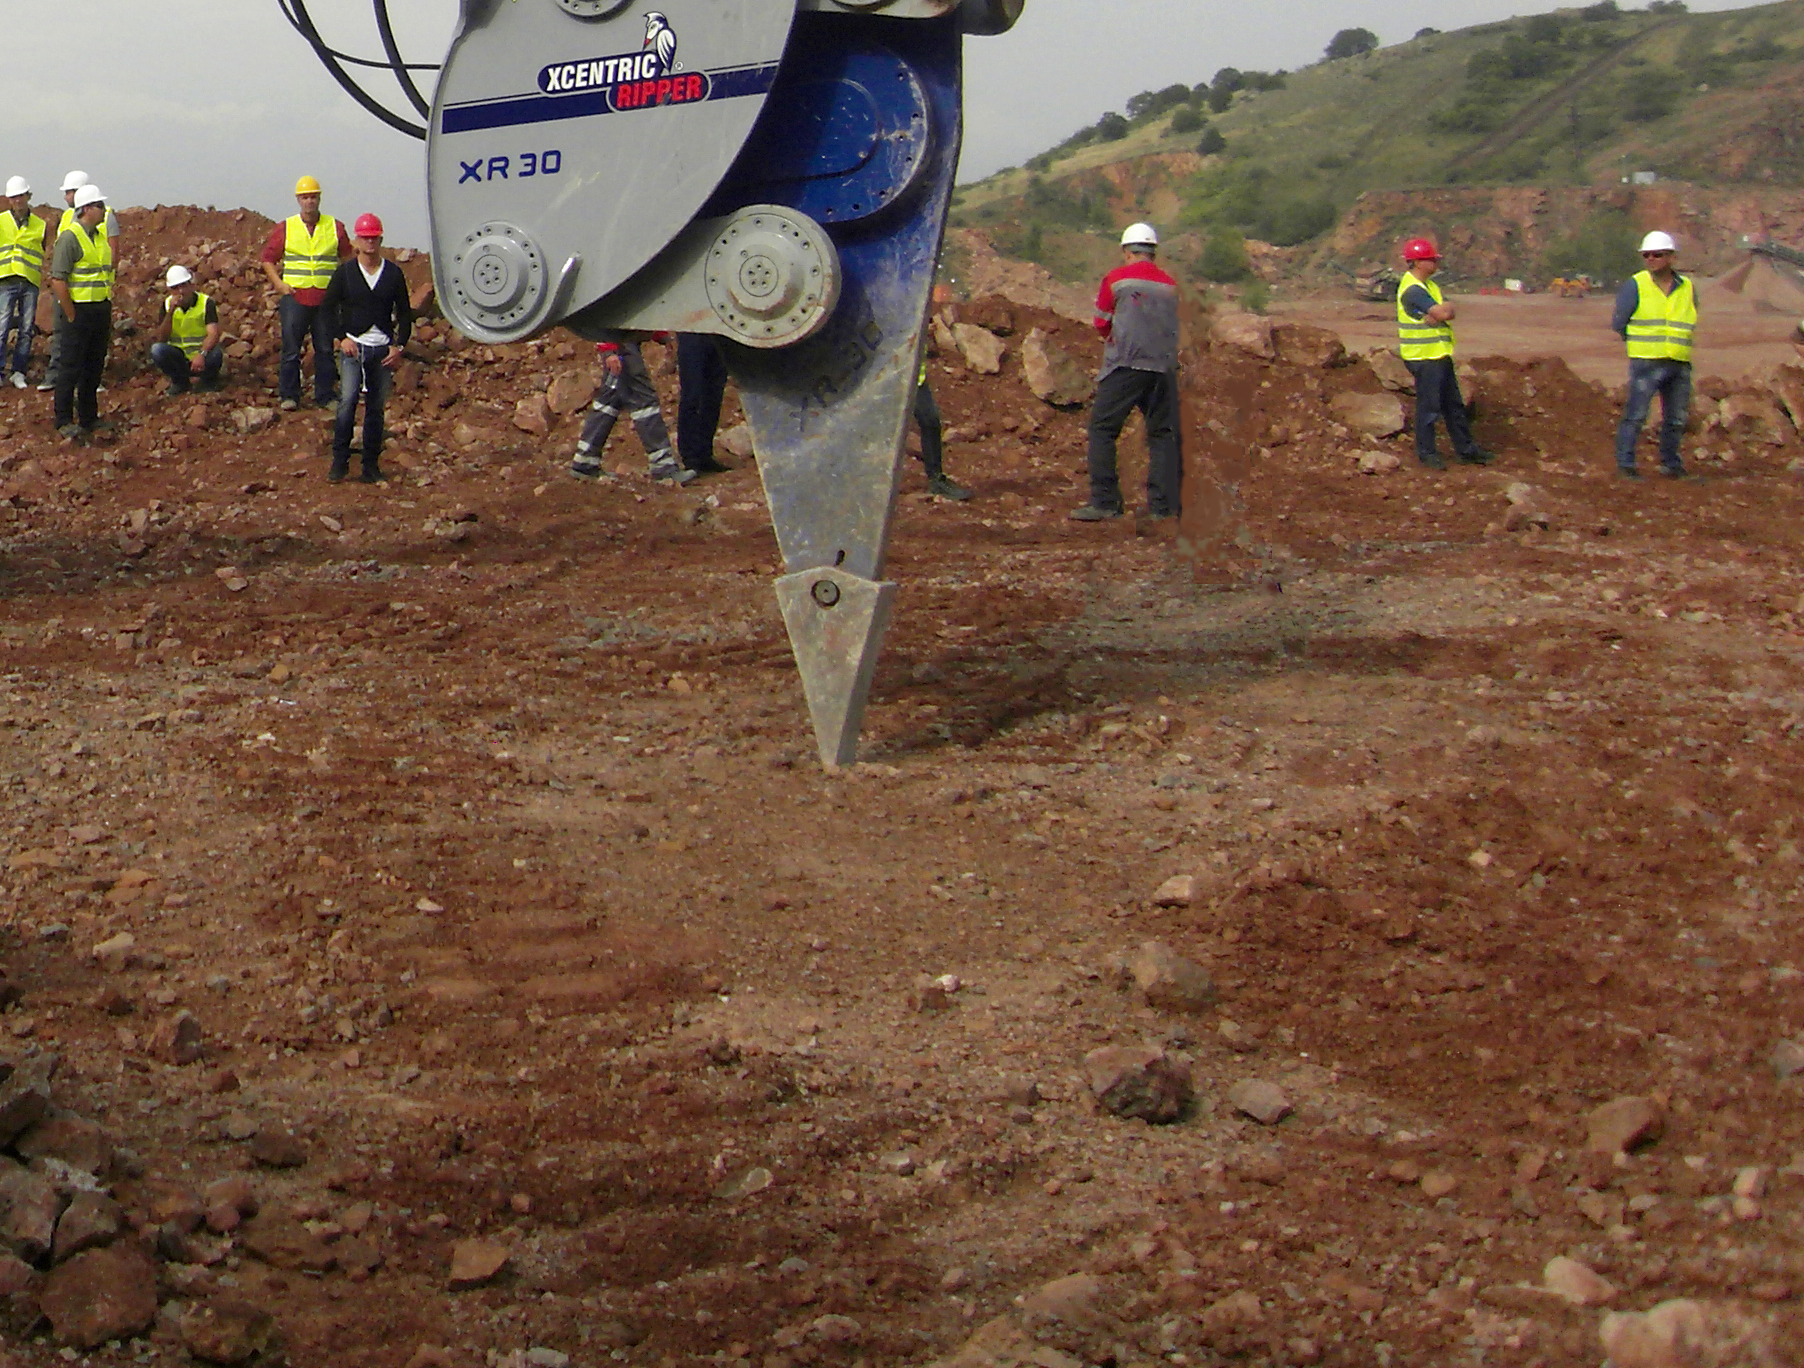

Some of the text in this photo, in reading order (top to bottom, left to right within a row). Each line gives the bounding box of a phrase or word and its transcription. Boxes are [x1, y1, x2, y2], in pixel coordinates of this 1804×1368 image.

[546, 53, 657, 92] XCENTRIC
[615, 75, 702, 109] RIPPER
[458, 149, 561, 184] XR 30
